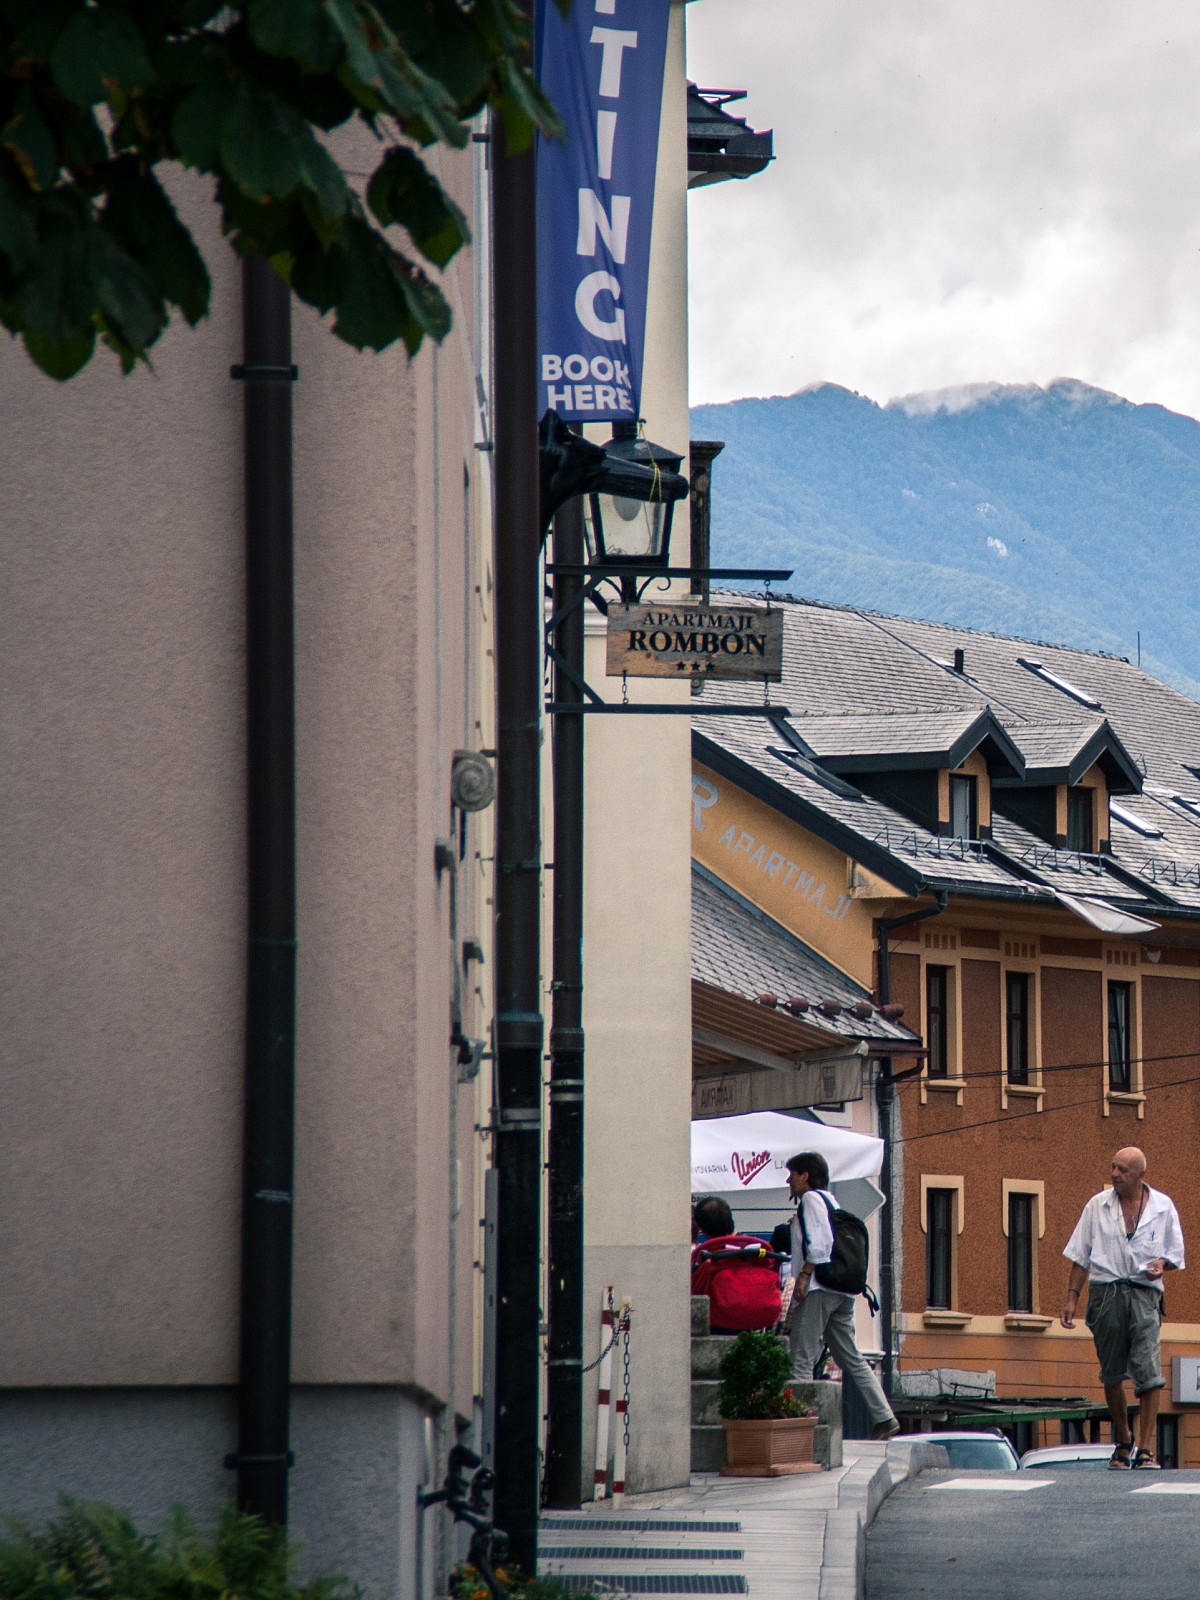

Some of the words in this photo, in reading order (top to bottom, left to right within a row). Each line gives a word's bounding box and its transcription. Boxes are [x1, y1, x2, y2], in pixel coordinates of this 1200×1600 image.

[575, 0, 638, 345] TING
[542, 353, 631, 390] BOOK
[547, 384, 634, 414] HERE
[642, 612, 754, 633] APARTMAJI
[626, 629, 767, 656] ROMBON
[718, 824, 853, 922] APARTMAJI
[731, 1149, 771, 1184] Union
